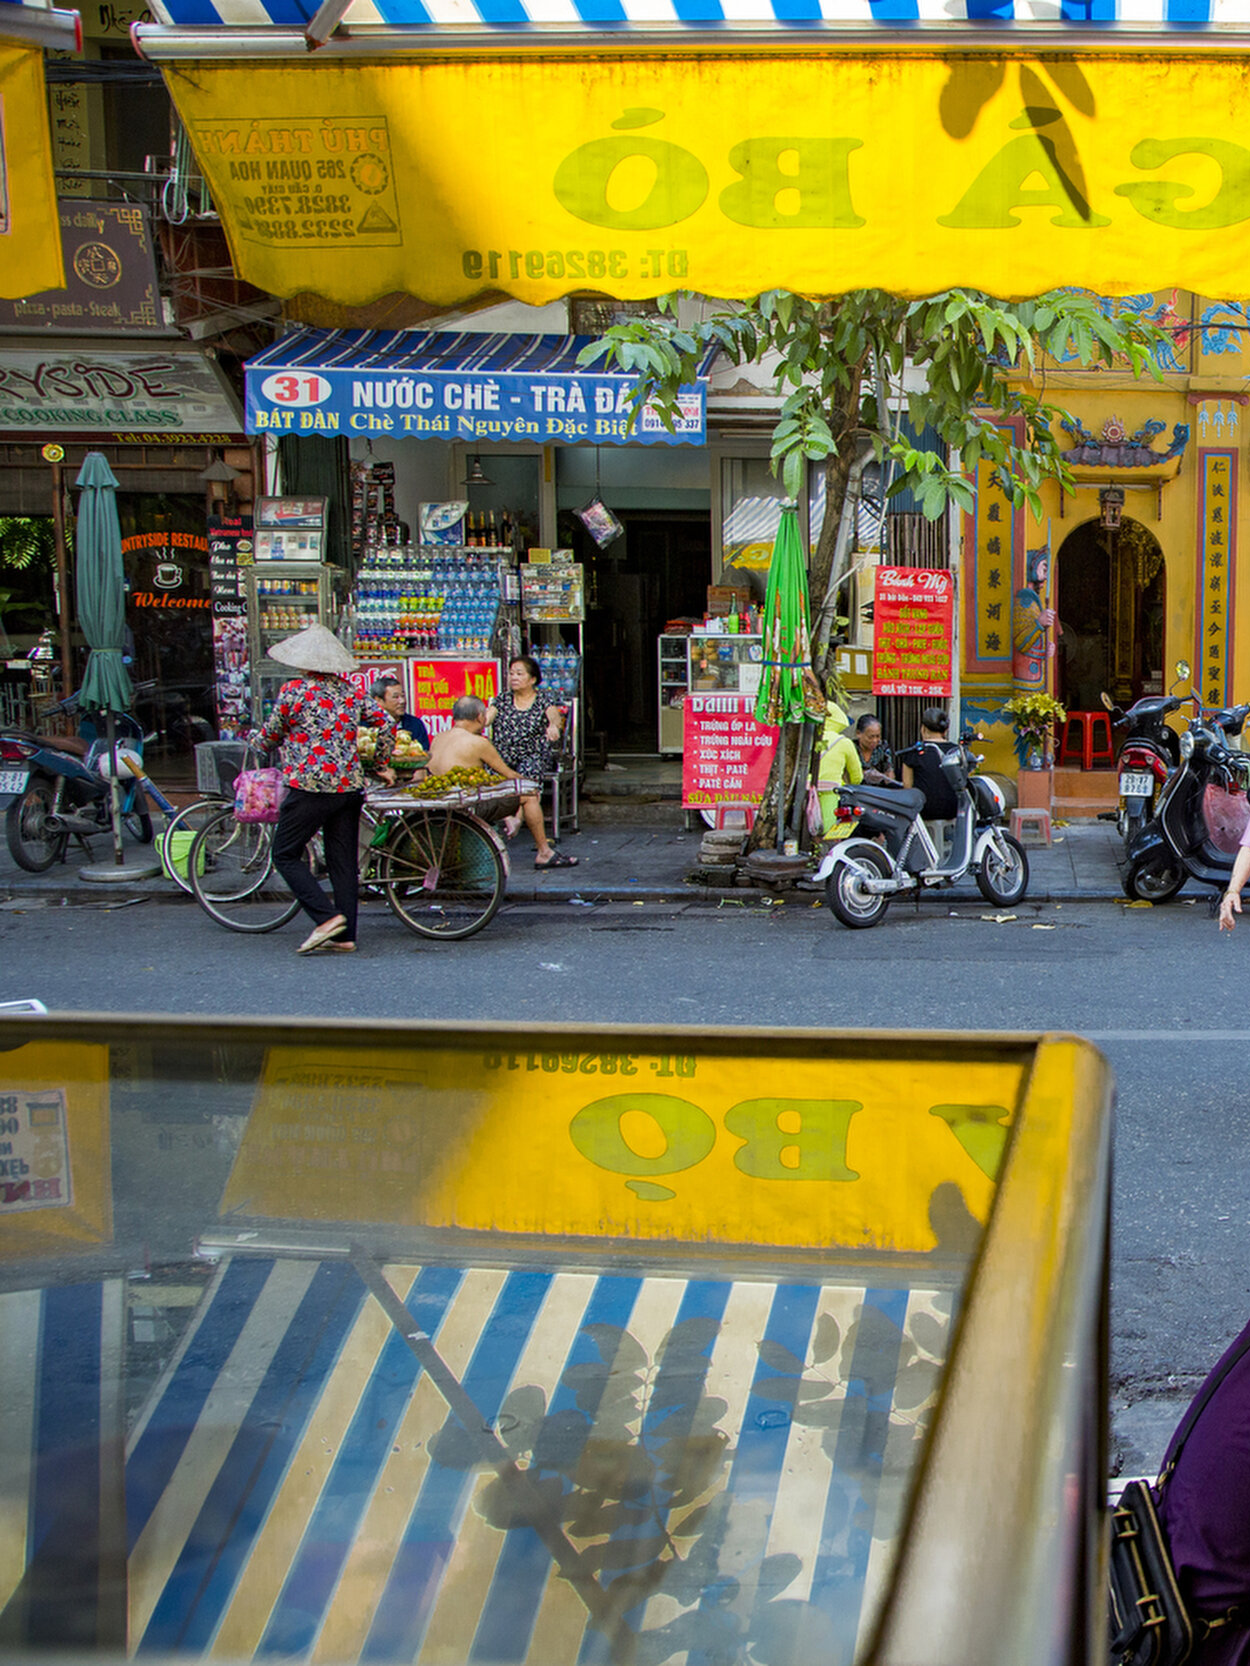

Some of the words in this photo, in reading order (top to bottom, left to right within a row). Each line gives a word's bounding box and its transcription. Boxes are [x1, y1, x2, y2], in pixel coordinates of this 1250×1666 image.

[274, 376, 320, 402] 31
[352, 376, 434, 409] NƯỚC
[443, 378, 501, 411] CHÈ
[530, 381, 587, 413] TRÀ
[594, 382, 634, 414] ĐÁ
[104, 409, 183, 427] CLASS
[255, 407, 295, 429] BÁT
[300, 408, 340, 430] ĐÀN
[350, 413, 394, 431] Chè
[400, 414, 450, 432] Thái
[457, 415, 540, 437] Nguyên
[546, 417, 588, 439] Đặc
[594, 418, 638, 440] Biệt
[131, 591, 212, 609] Welcome
[745, 721, 757, 732] LA
